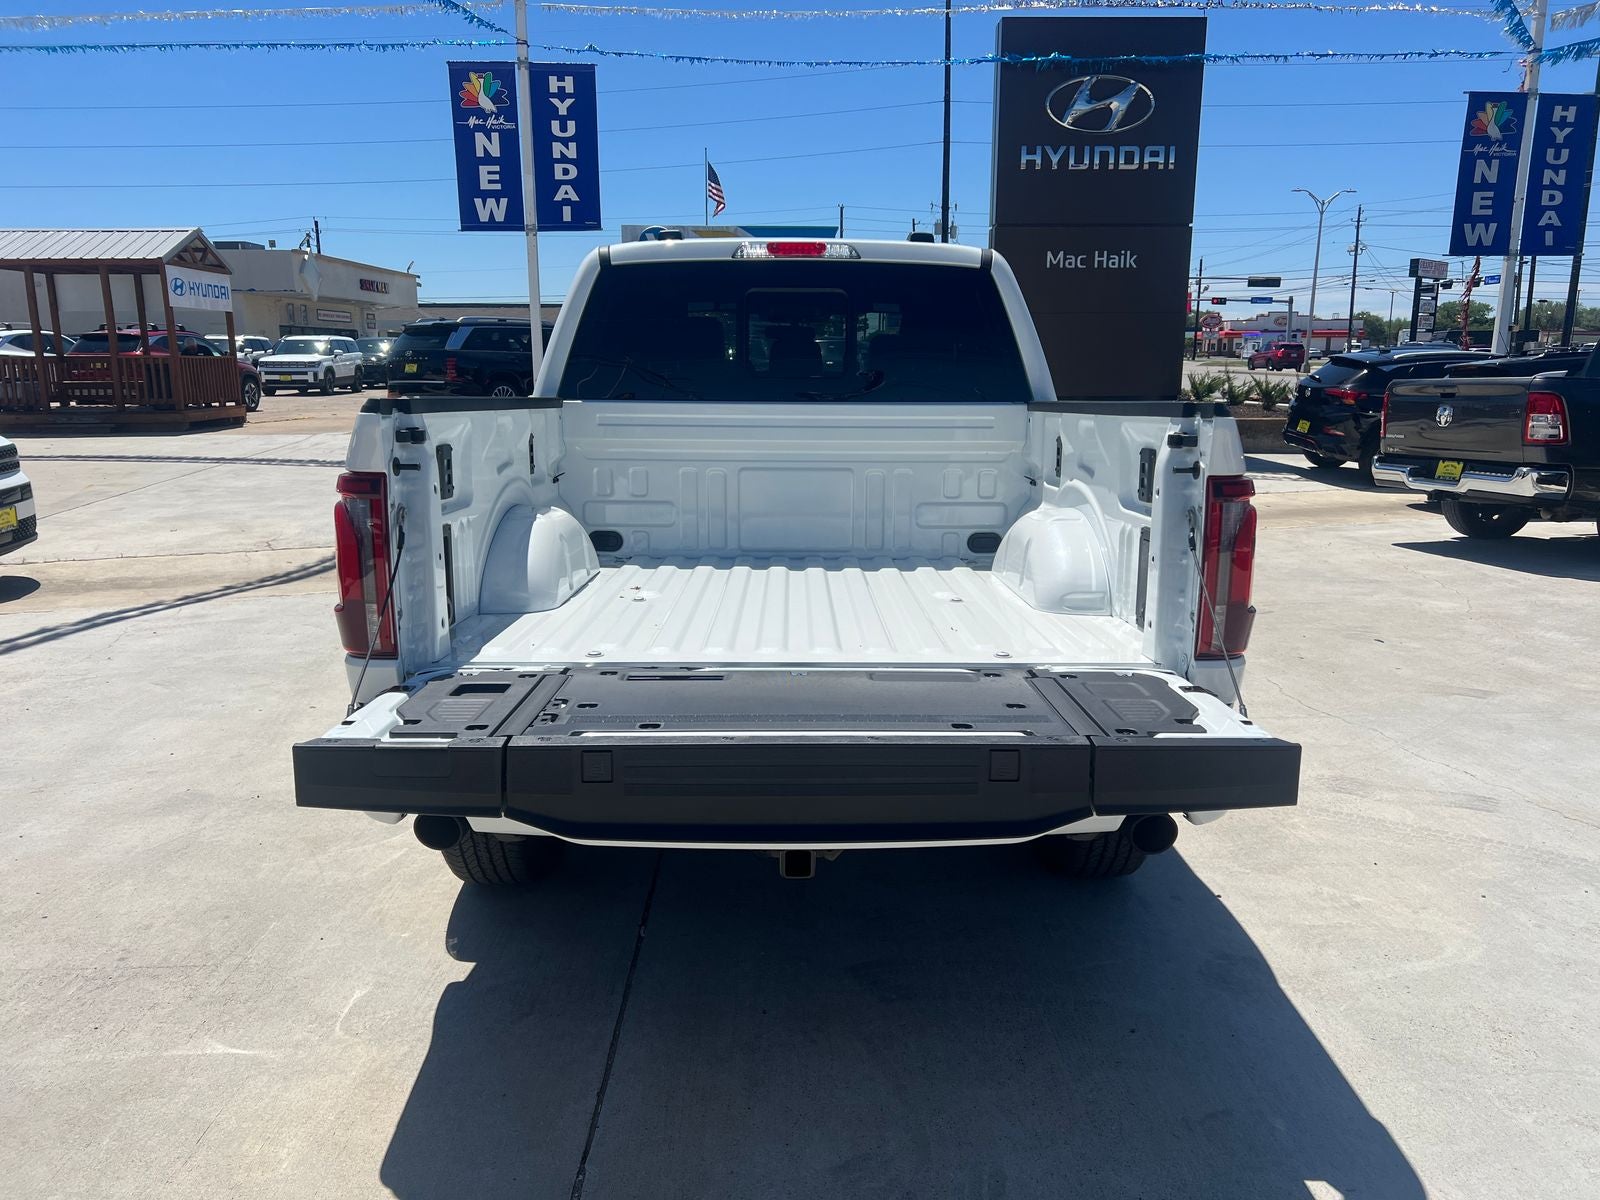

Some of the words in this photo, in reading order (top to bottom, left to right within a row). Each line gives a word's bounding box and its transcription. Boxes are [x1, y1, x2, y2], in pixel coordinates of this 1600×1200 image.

[473, 131, 508, 222] NEW
[548, 75, 580, 222] HYUNDAI
[1019, 145, 1176, 170] HYUNDAI
[1537, 105, 1577, 246] HYUNDAI
[1463, 159, 1499, 247] NEW
[188, 281, 230, 300] HYUNDAI
[1046, 250, 1087, 269] Mac
[1094, 250, 1138, 269] Haik
